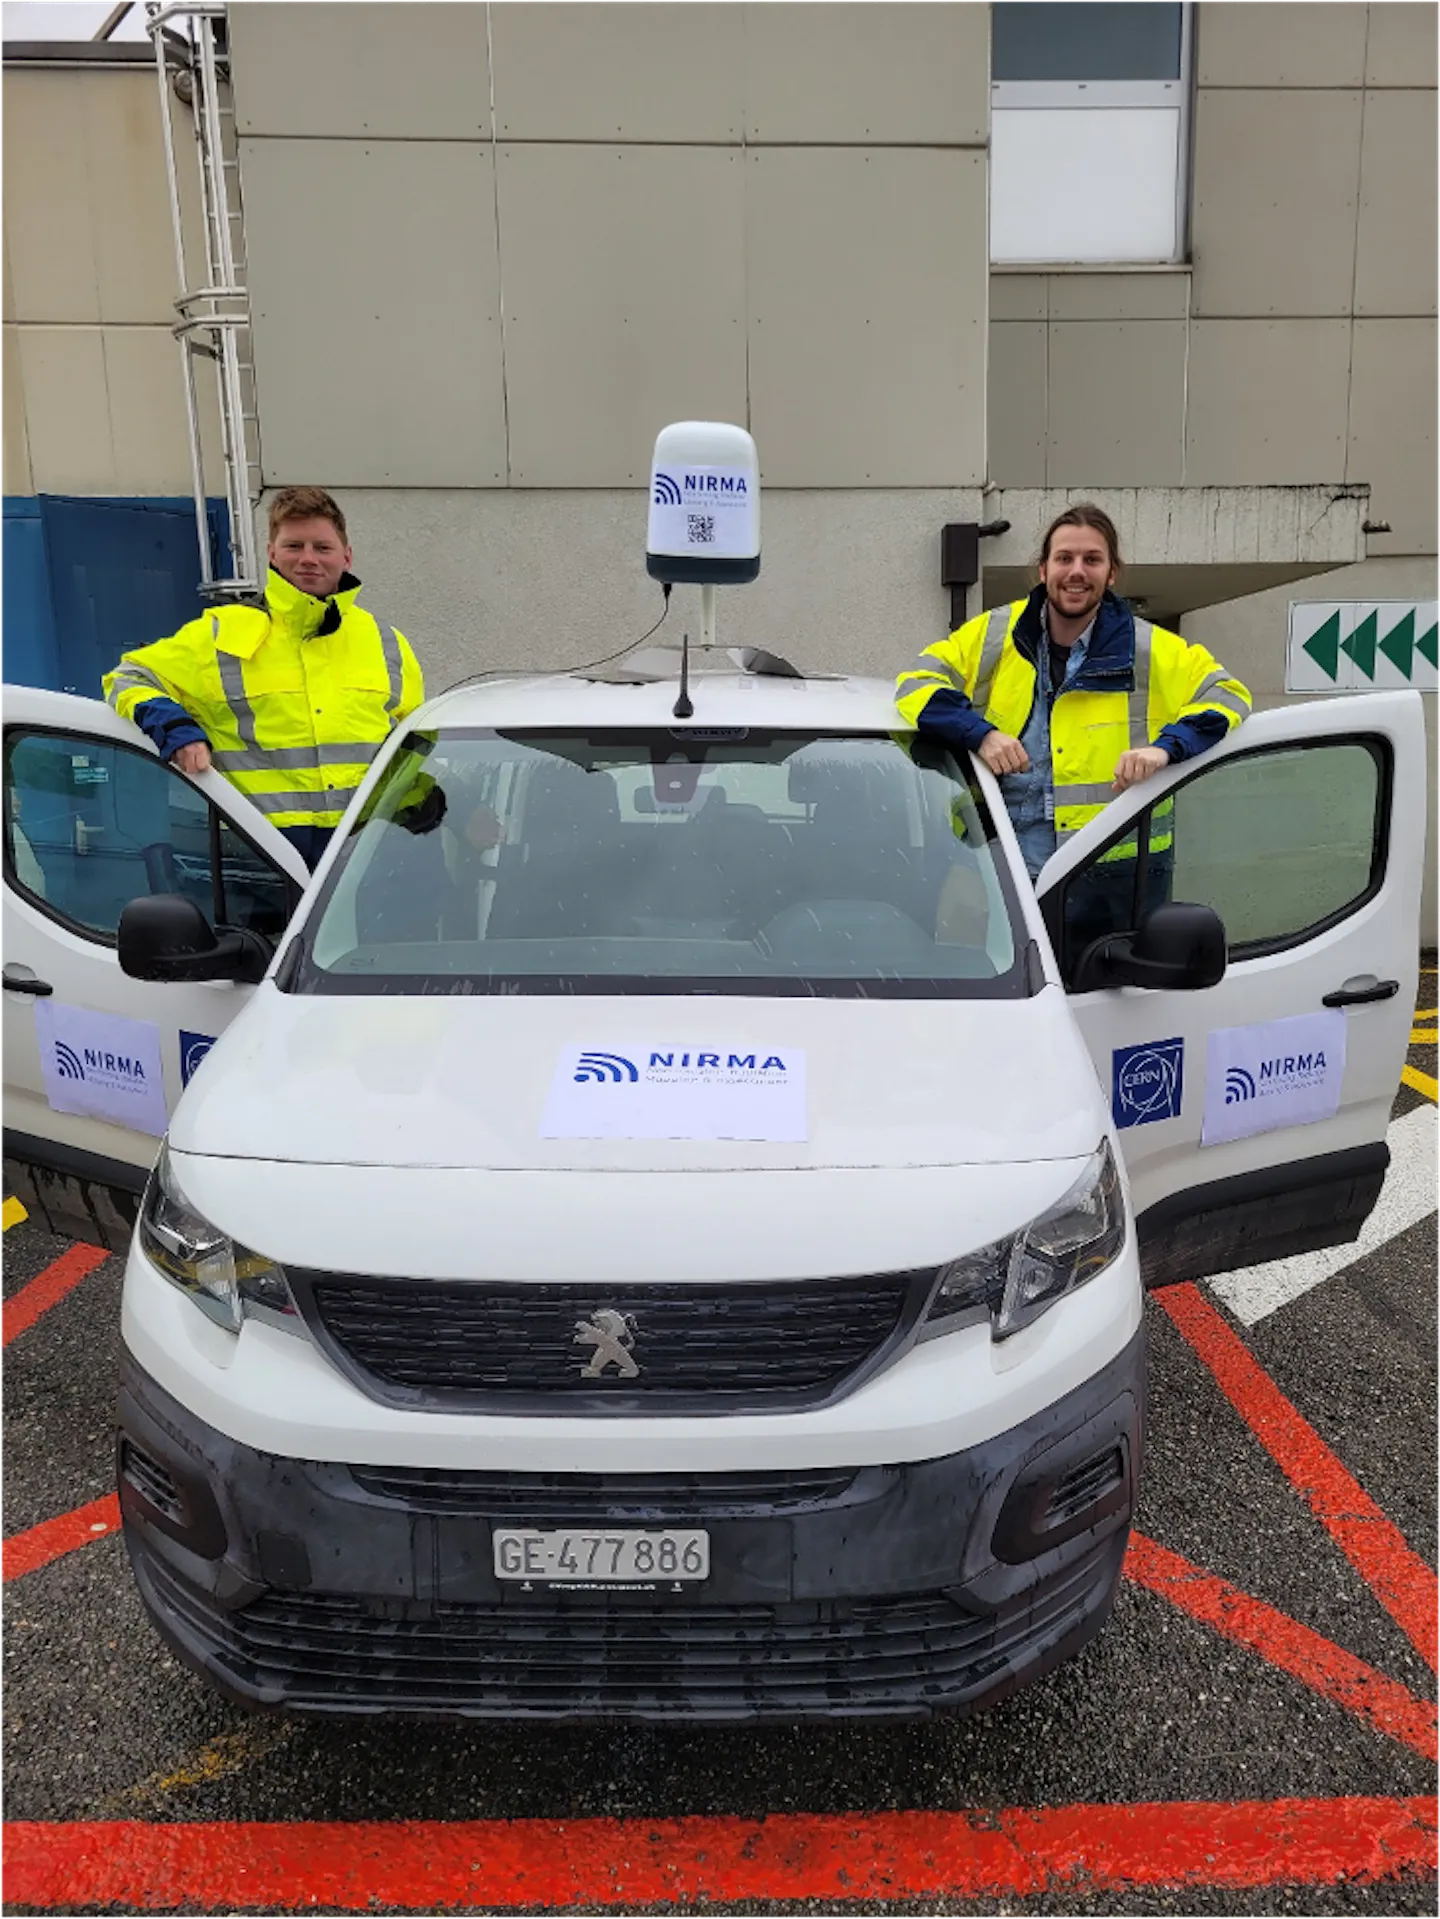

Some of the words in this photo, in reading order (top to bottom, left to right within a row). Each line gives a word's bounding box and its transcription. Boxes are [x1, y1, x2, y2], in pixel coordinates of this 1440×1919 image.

[684, 475, 748, 493] NIRMA
[84, 1048, 146, 1079] NIRMA
[649, 1052, 787, 1071] NIRMA
[1259, 1050, 1327, 1080] NIRMA
[1123, 1069, 1160, 1087] CERN
